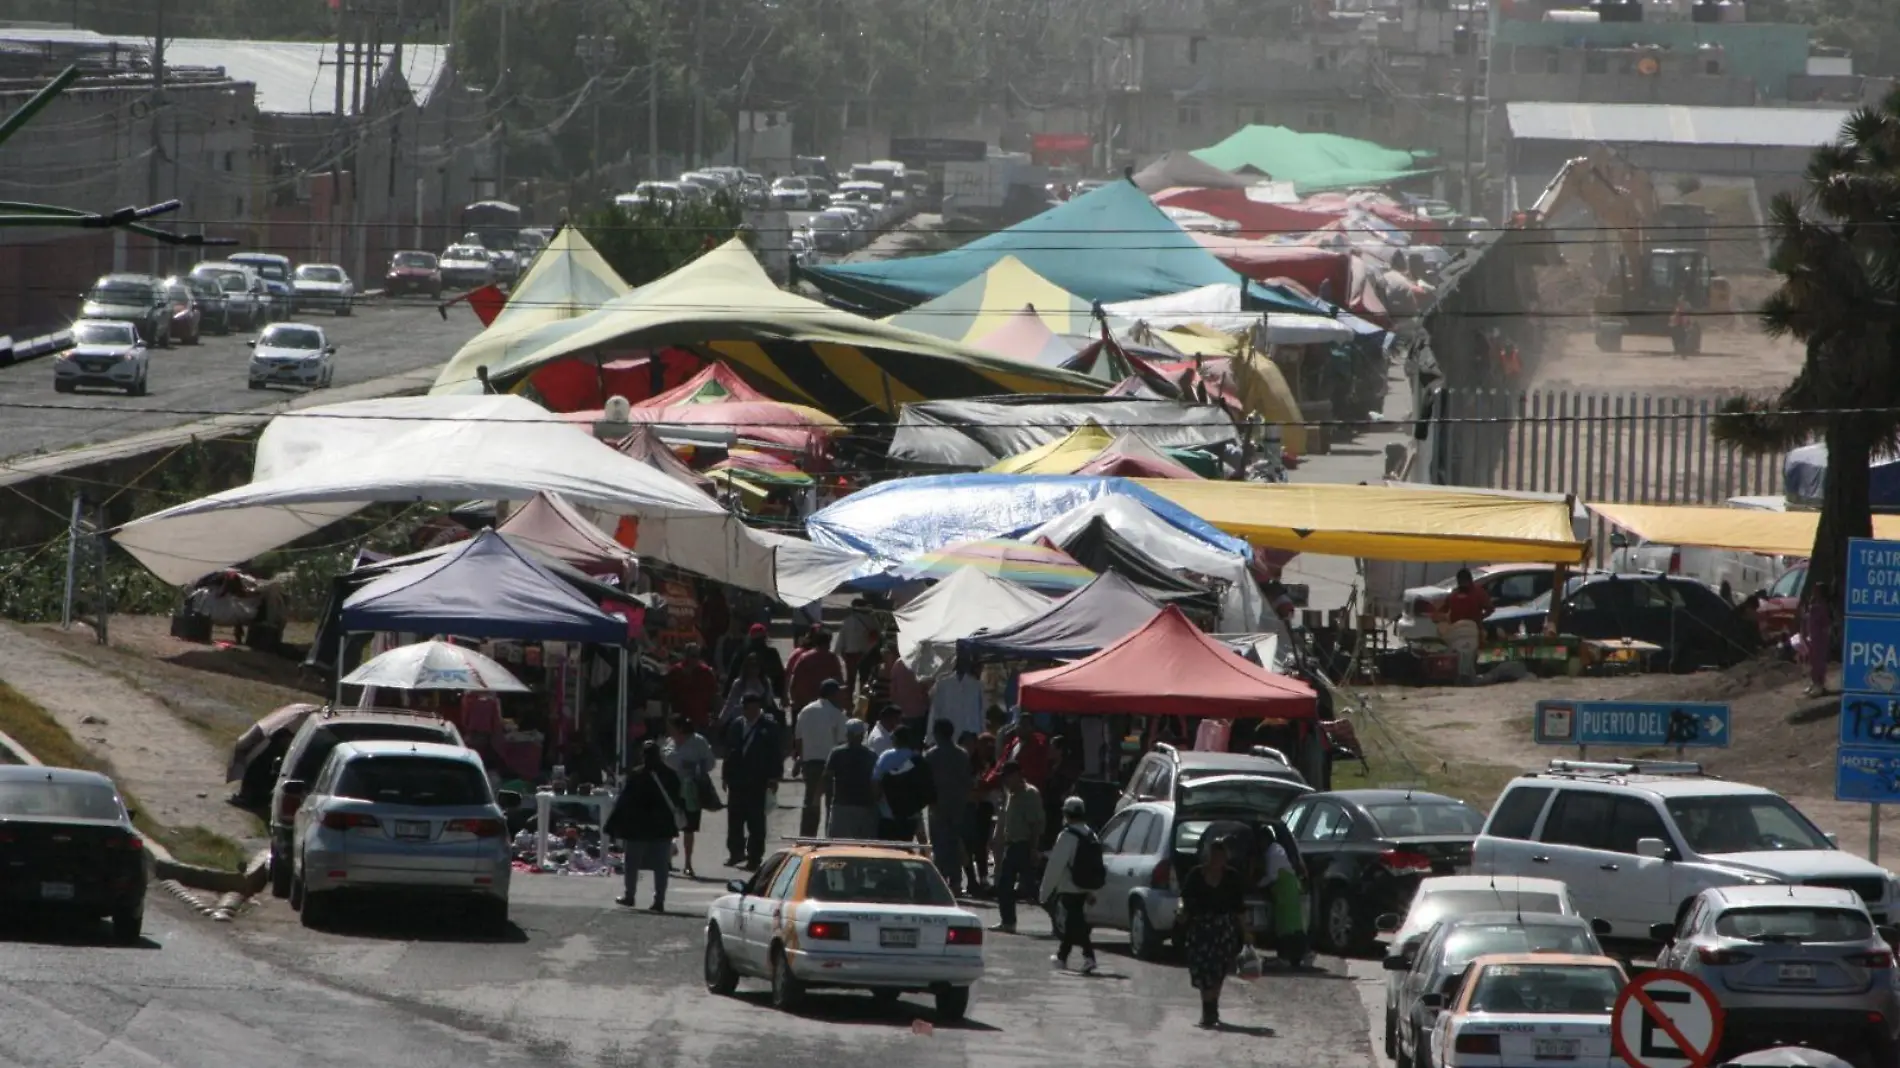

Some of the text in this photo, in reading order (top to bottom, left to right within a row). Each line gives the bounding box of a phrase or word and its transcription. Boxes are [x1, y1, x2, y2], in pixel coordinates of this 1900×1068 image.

[1851, 588, 1869, 604] DE
[1582, 712, 1635, 735] PUERTO
[1638, 712, 1665, 735] DEL
[1641, 989, 1691, 1059] E
